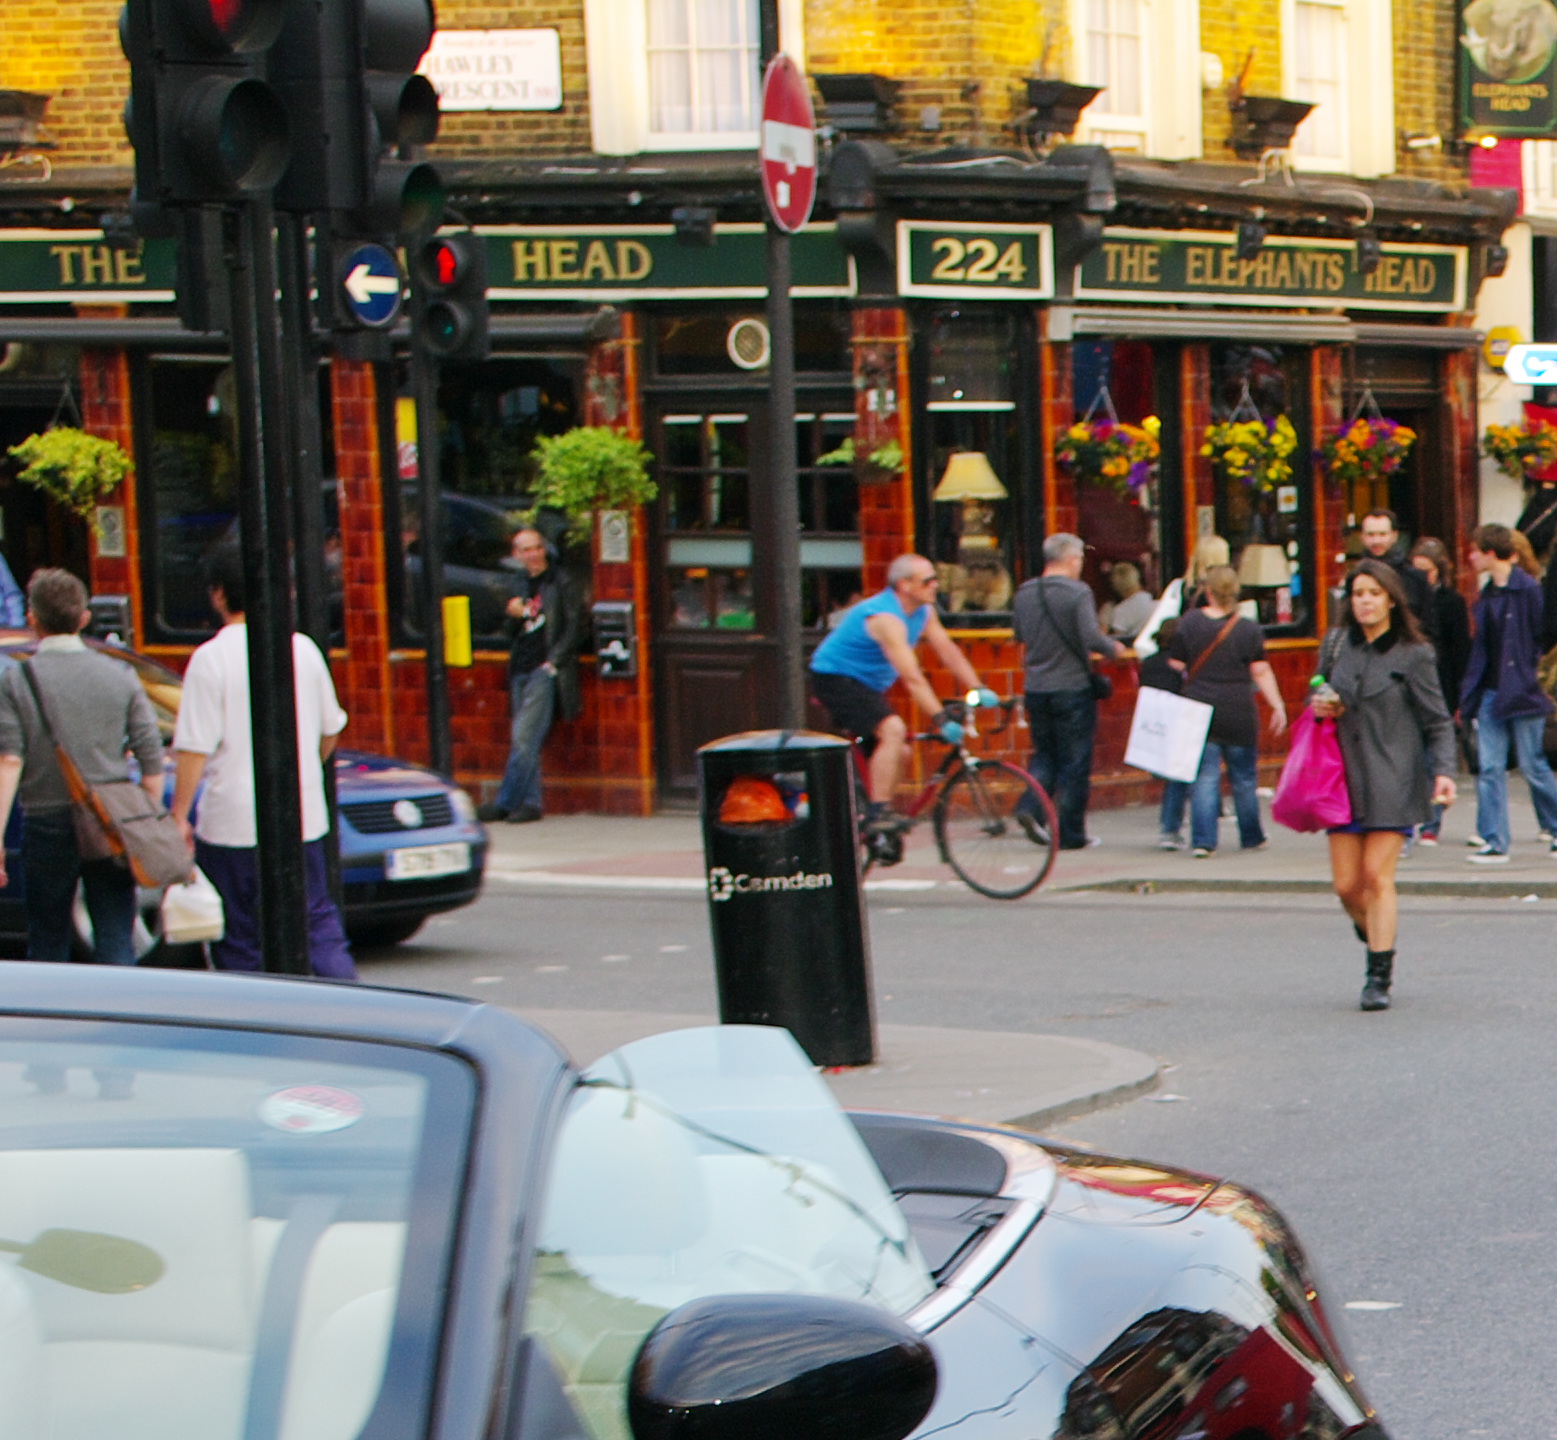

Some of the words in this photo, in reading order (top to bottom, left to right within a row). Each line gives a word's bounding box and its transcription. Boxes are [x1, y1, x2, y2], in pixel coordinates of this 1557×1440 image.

[426, 55, 515, 75] HAWLEY
[438, 79, 530, 100] RESCENT
[1490, 96, 1531, 112] HEAD
[52, 245, 146, 285] THE
[512, 239, 654, 282] HEAD
[931, 237, 1027, 283] 224
[1103, 243, 1162, 284] THE
[1186, 252, 1345, 292] ELEPHANTS
[1364, 257, 1437, 294] HEAD
[735, 871, 833, 893] Camden
